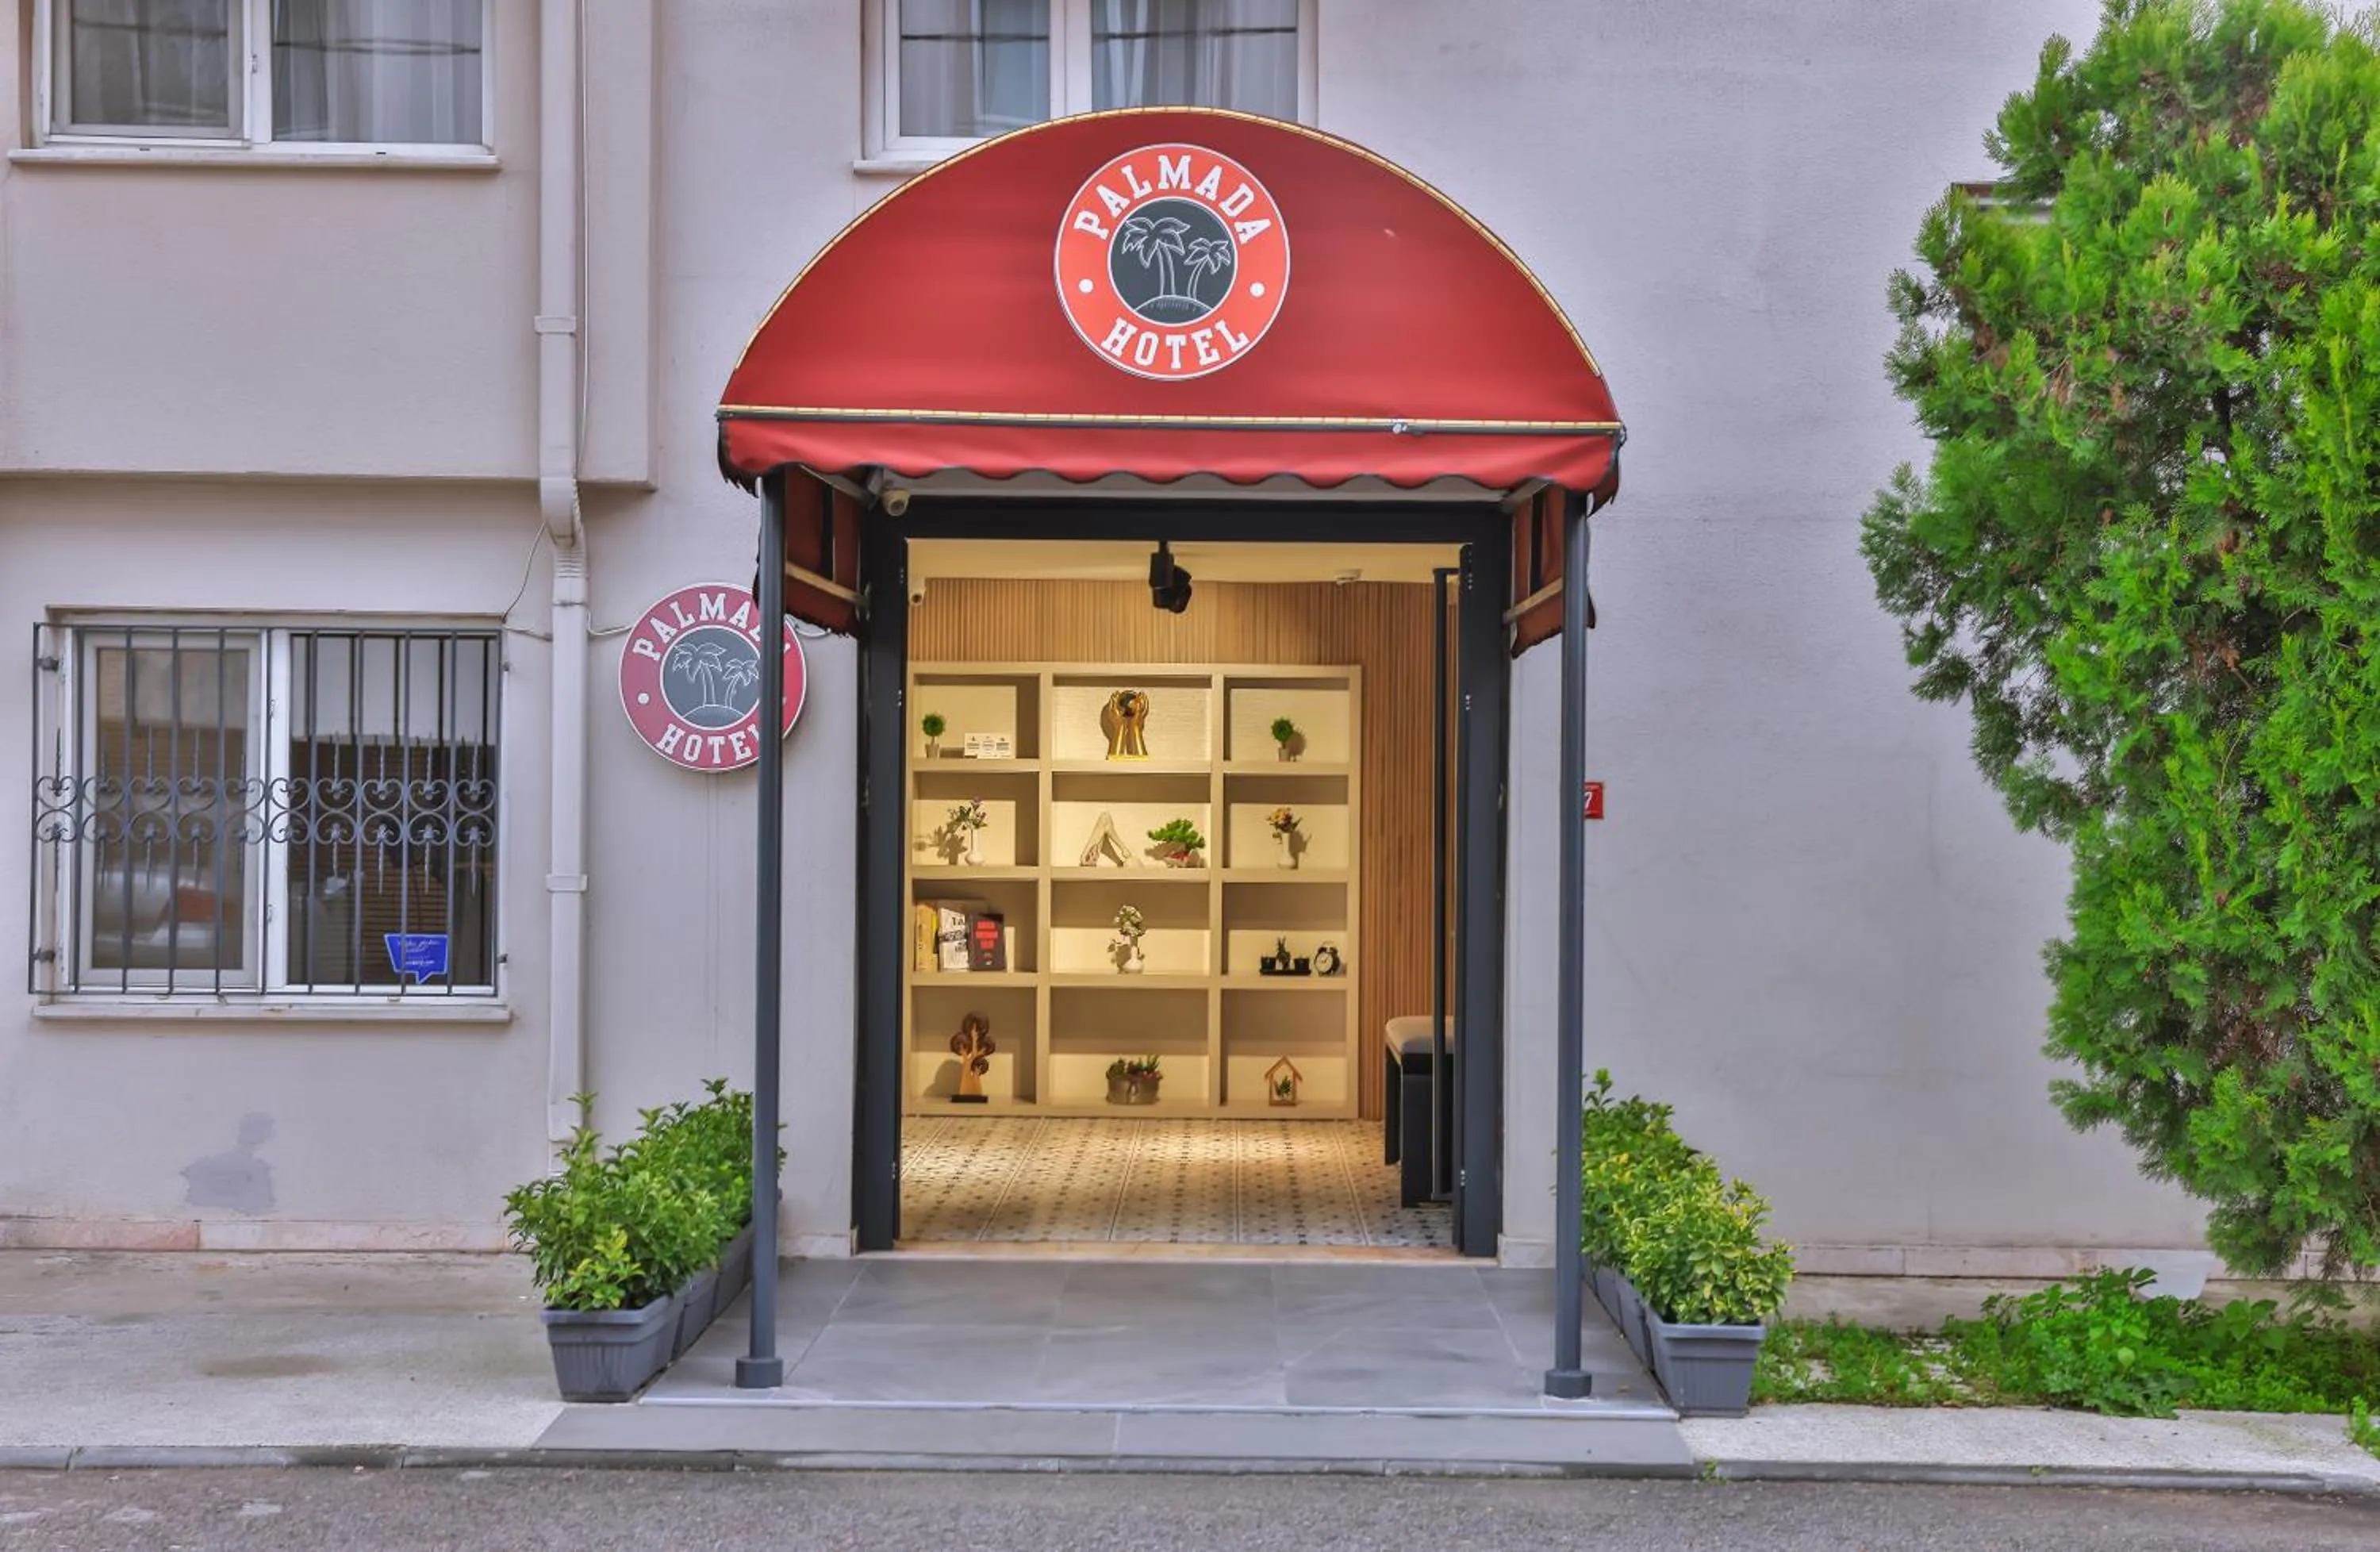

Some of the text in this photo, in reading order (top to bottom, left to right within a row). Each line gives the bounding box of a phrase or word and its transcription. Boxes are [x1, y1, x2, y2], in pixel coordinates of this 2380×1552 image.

[1073, 155, 1271, 244] PALMADA
[1100, 317, 1250, 369] HOTEL
[632, 593, 790, 661] PALMA
